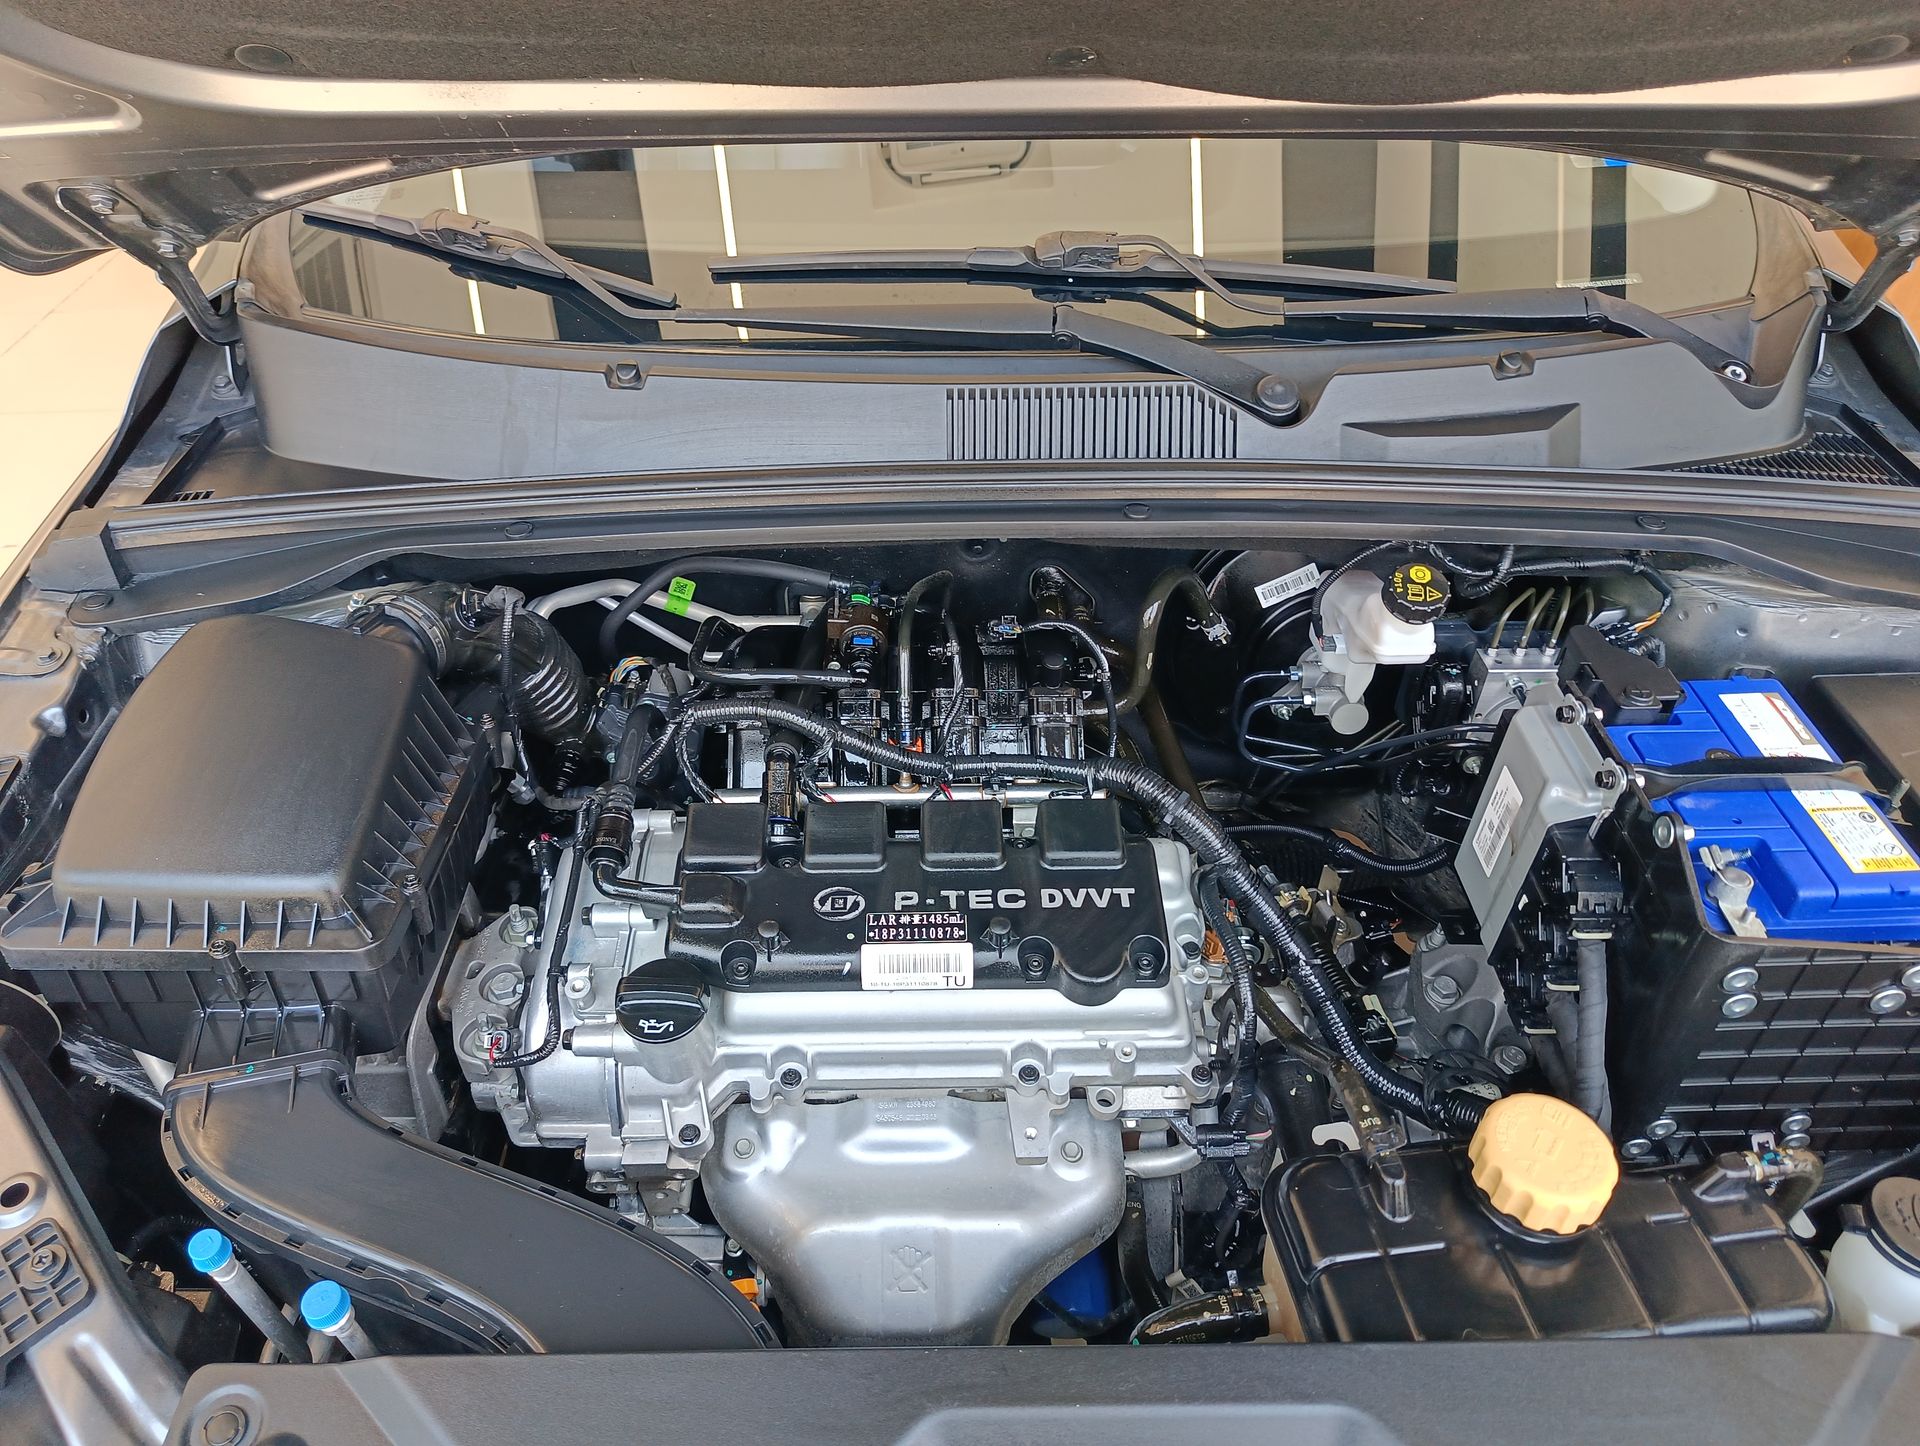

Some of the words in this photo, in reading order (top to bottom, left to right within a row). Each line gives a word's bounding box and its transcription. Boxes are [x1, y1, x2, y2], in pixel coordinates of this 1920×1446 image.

[1040, 887, 1136, 909] DVVT
[868, 914, 897, 926] LAR
[942, 975, 966, 987] TU
[1217, 1294, 1230, 1314] SUR
